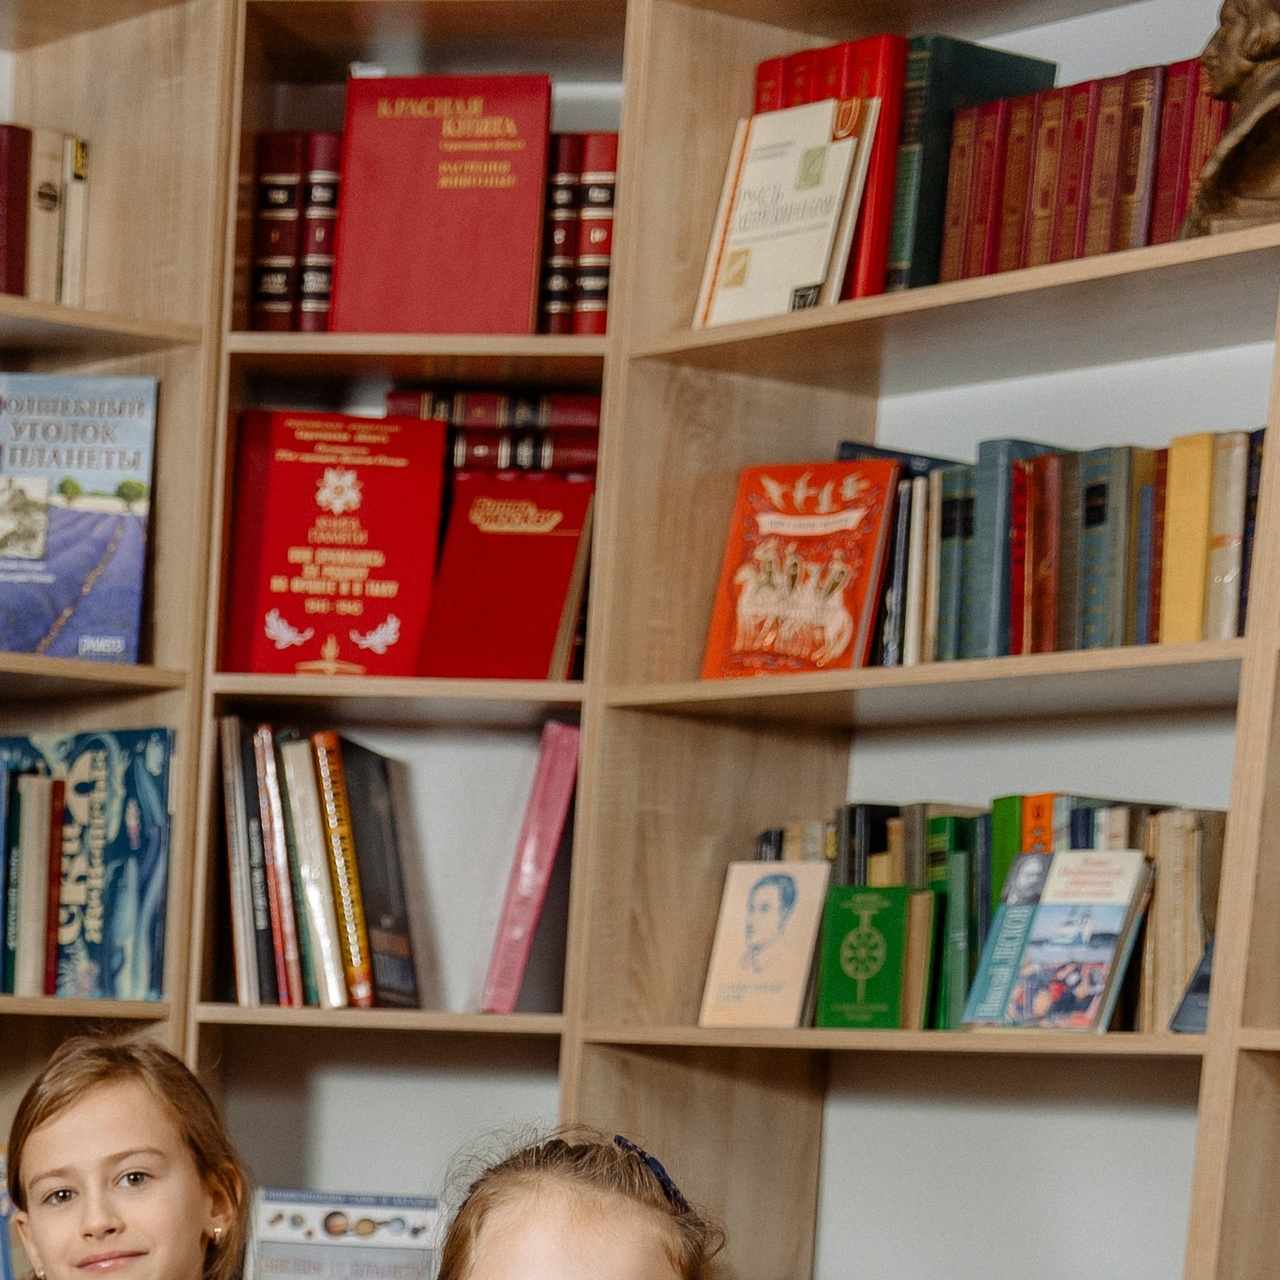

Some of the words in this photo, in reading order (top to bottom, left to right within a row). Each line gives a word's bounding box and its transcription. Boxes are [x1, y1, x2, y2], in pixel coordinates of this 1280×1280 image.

[377, 96, 484, 118] КРАСНАЯ
[442, 116, 518, 137] КНИГА
[10, 420, 118, 444] УГОЛОК
[9, 447, 142, 471] ПЛАНЕТЫ
[991, 907, 1031, 965] ЛЕСКОВ
